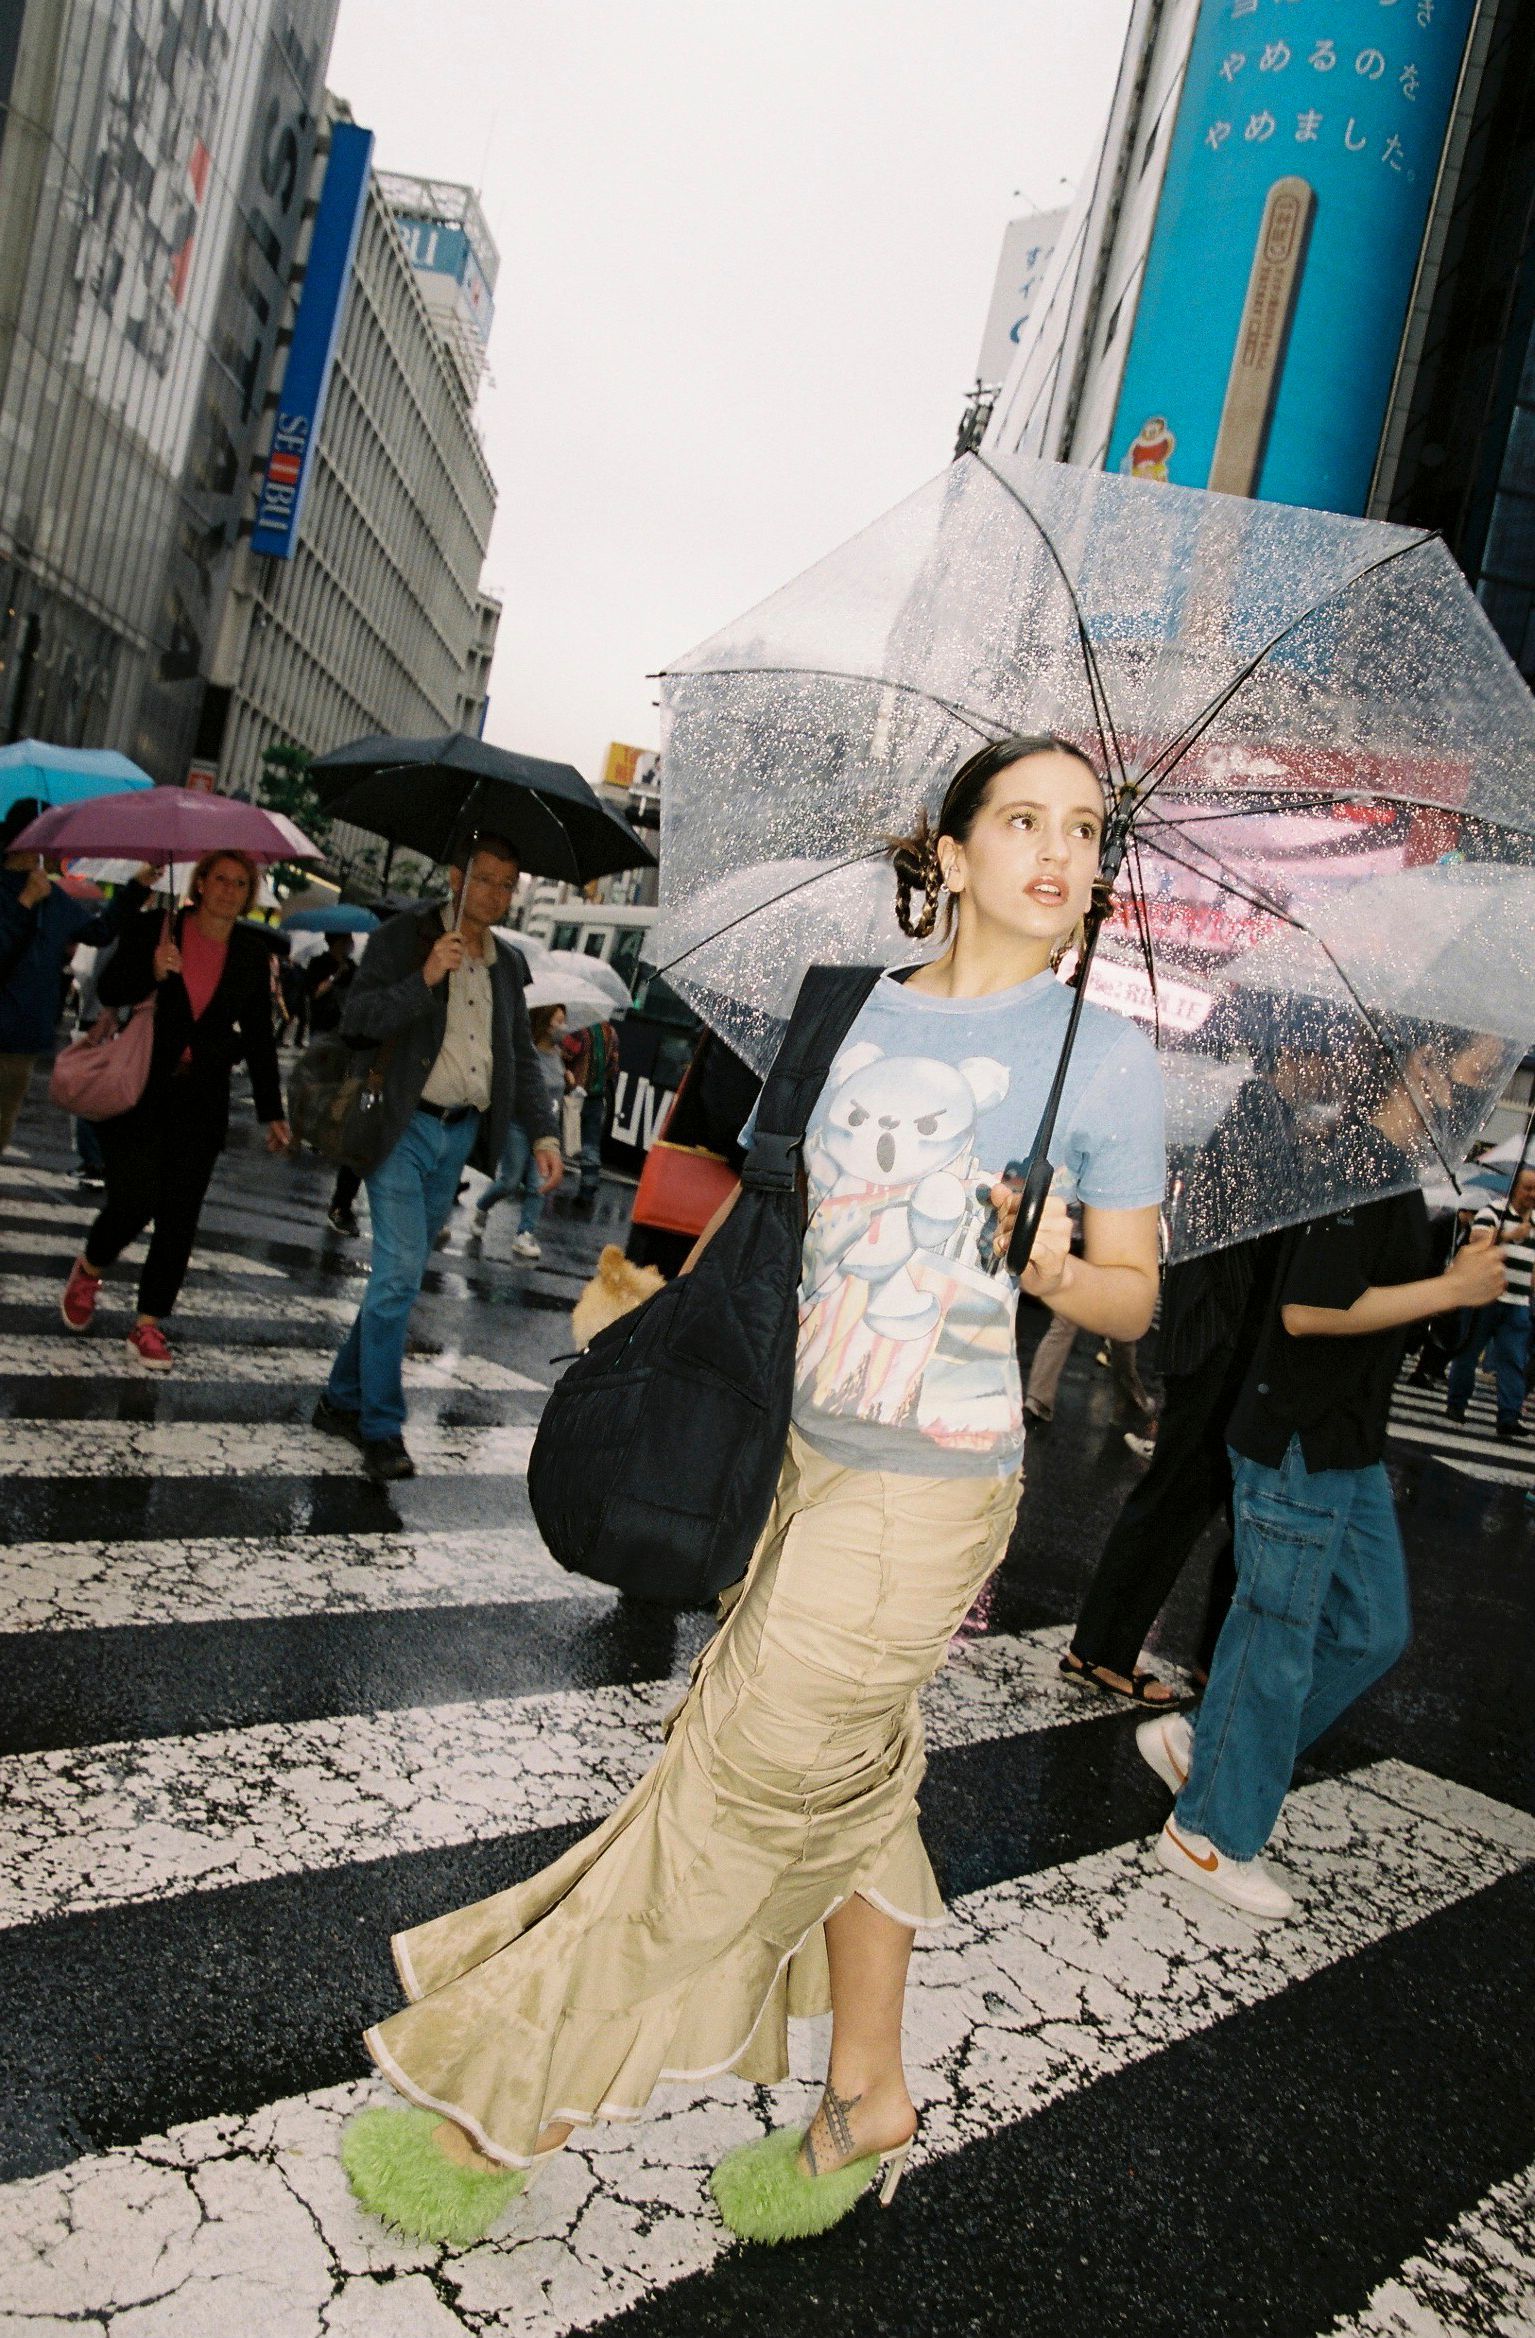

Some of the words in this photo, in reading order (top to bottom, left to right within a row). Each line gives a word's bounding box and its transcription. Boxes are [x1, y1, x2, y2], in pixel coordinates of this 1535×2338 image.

[1219, 39, 1420, 101] やめるのを
[1205, 108, 1416, 183] やめました。
